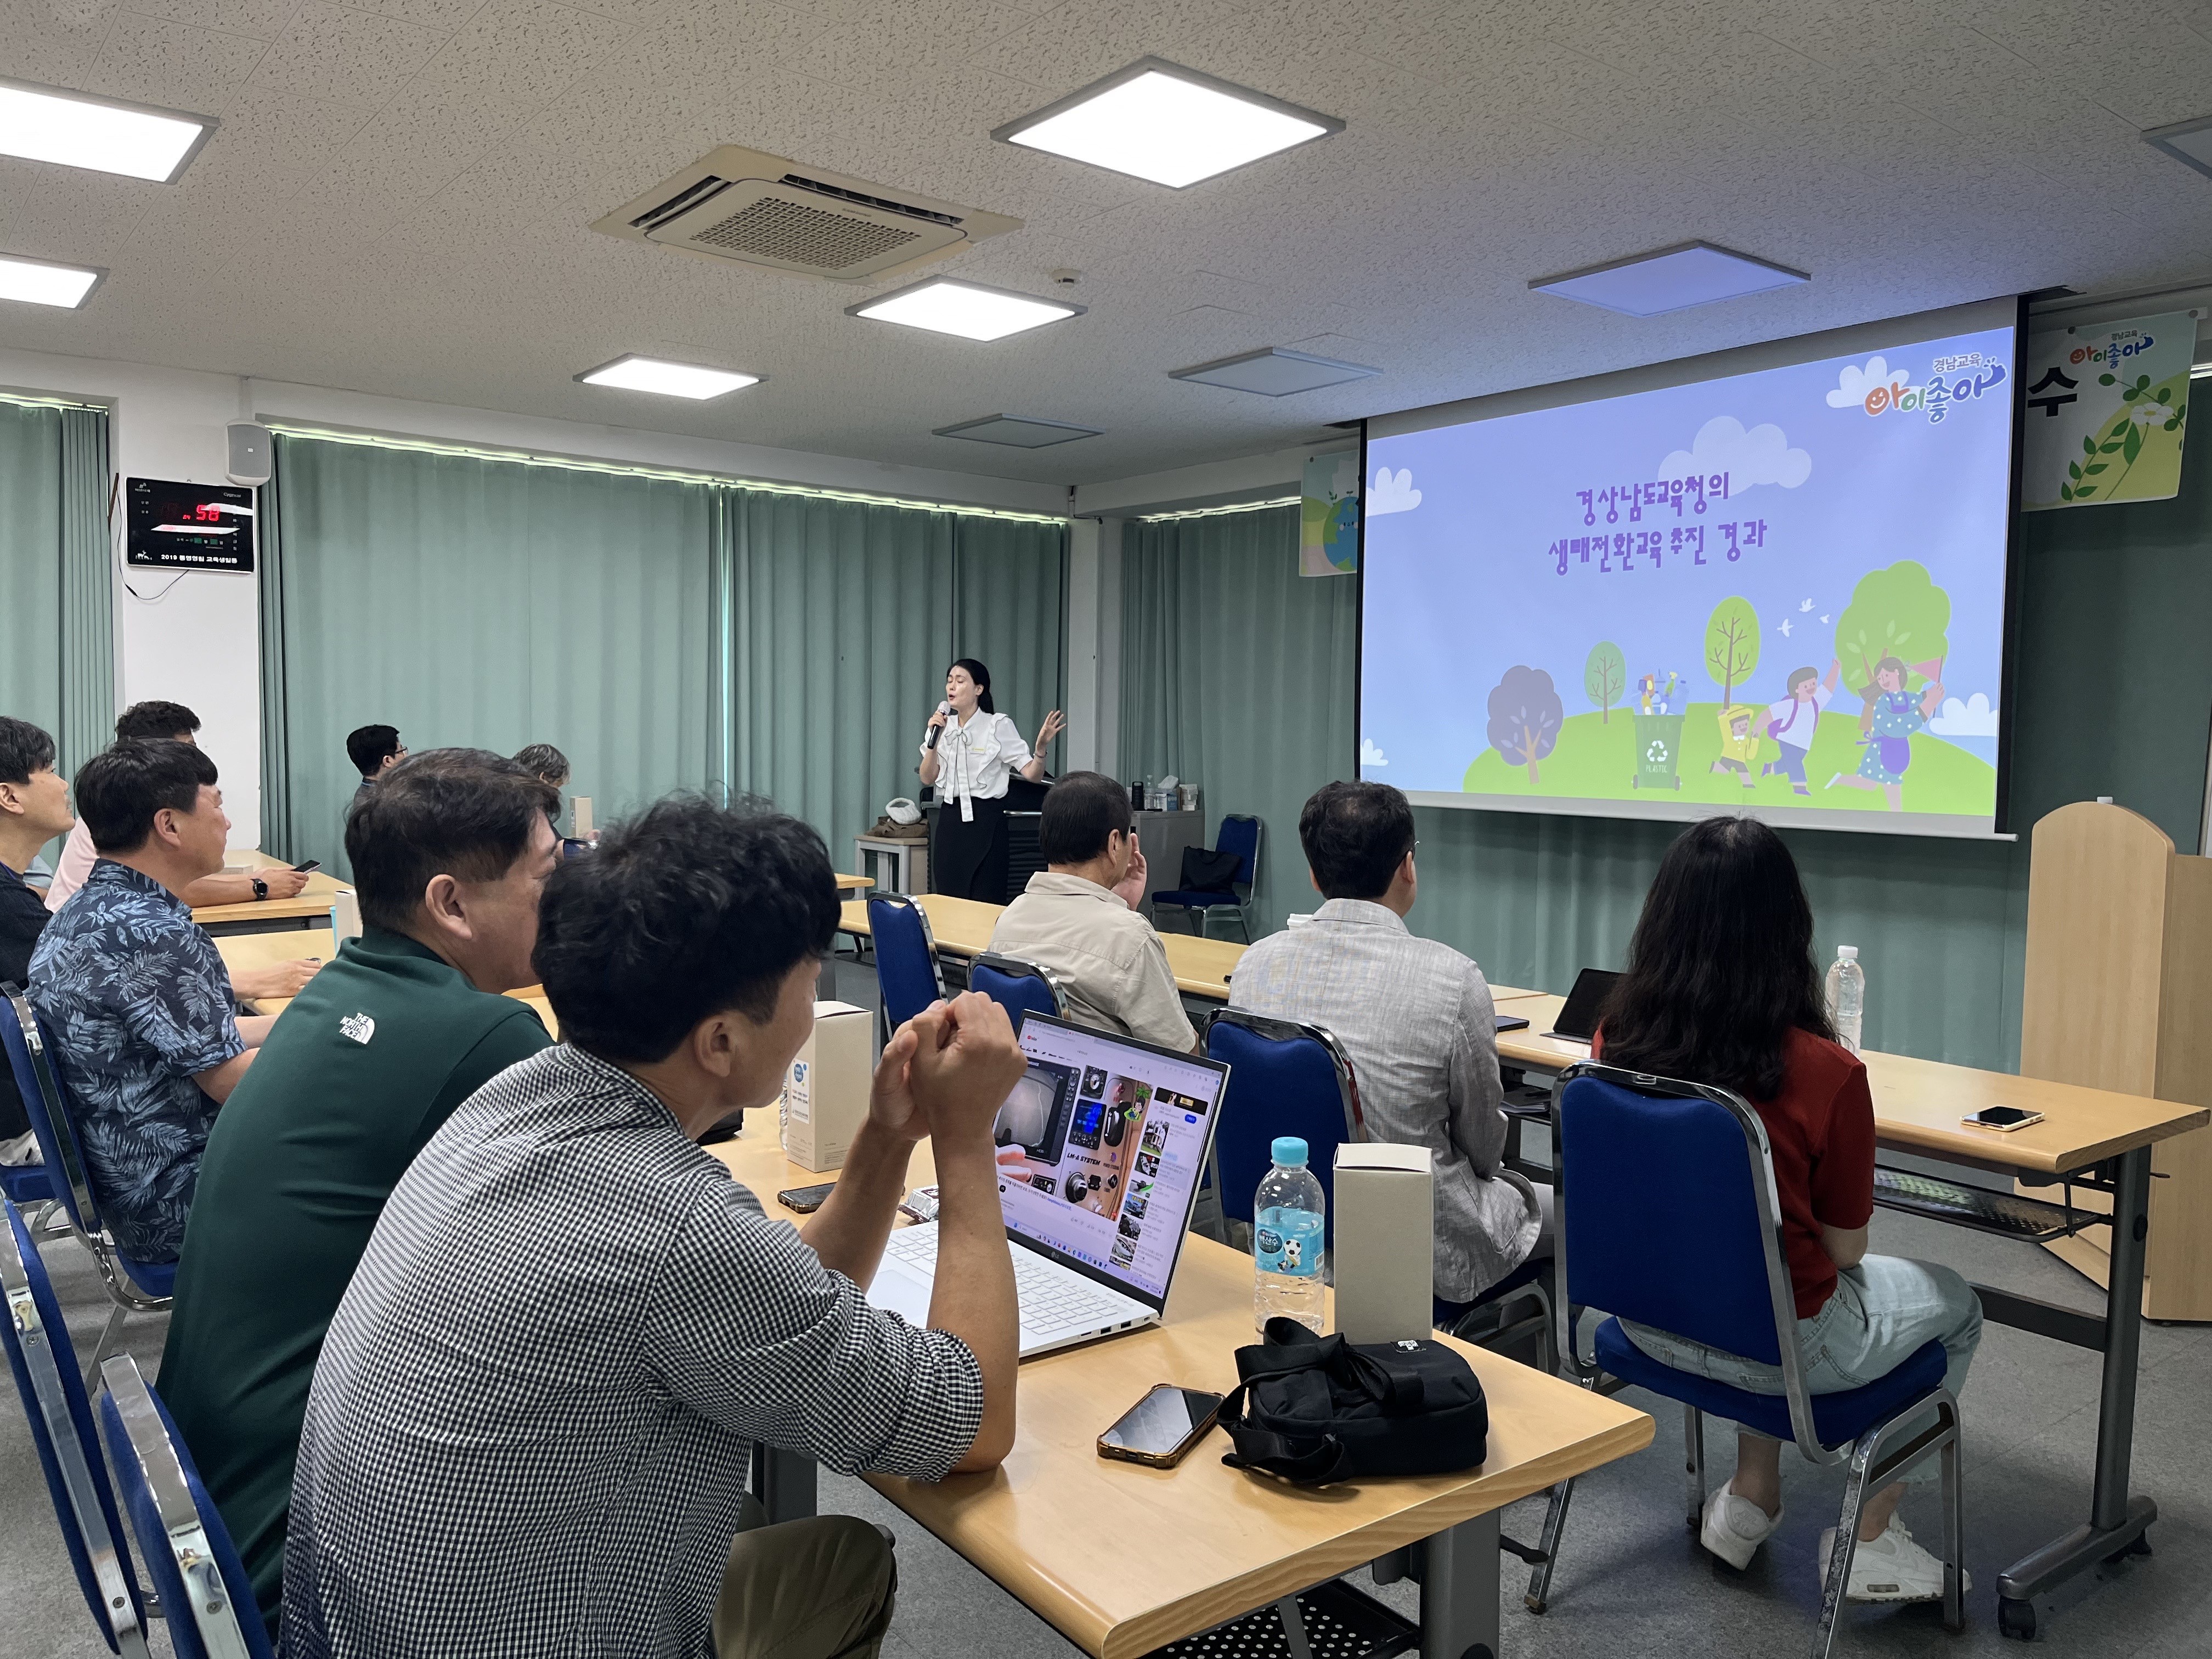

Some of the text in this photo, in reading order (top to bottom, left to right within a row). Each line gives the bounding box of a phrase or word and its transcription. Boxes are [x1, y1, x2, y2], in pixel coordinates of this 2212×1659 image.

[2111, 330, 2138, 341] 경남교육
[2069, 335, 2154, 369] 아이좋아
[1933, 353, 1981, 373] 경남교육
[1864, 362, 2007, 424] 아이좋아
[2027, 366, 2079, 417] 수
[1576, 471, 1729, 527] 경상남도교육청의
[1548, 518, 1768, 577] 생태전환교육 추진 경과
[1646, 764, 1668, 774] PLASTIC
[340, 1015, 363, 1032] NORTH
[354, 1012, 370, 1025] THE
[339, 1025, 359, 1039] FACE
[1080, 1156, 1101, 1166] SYSTEM
[1259, 1234, 1279, 1247] 백산수
